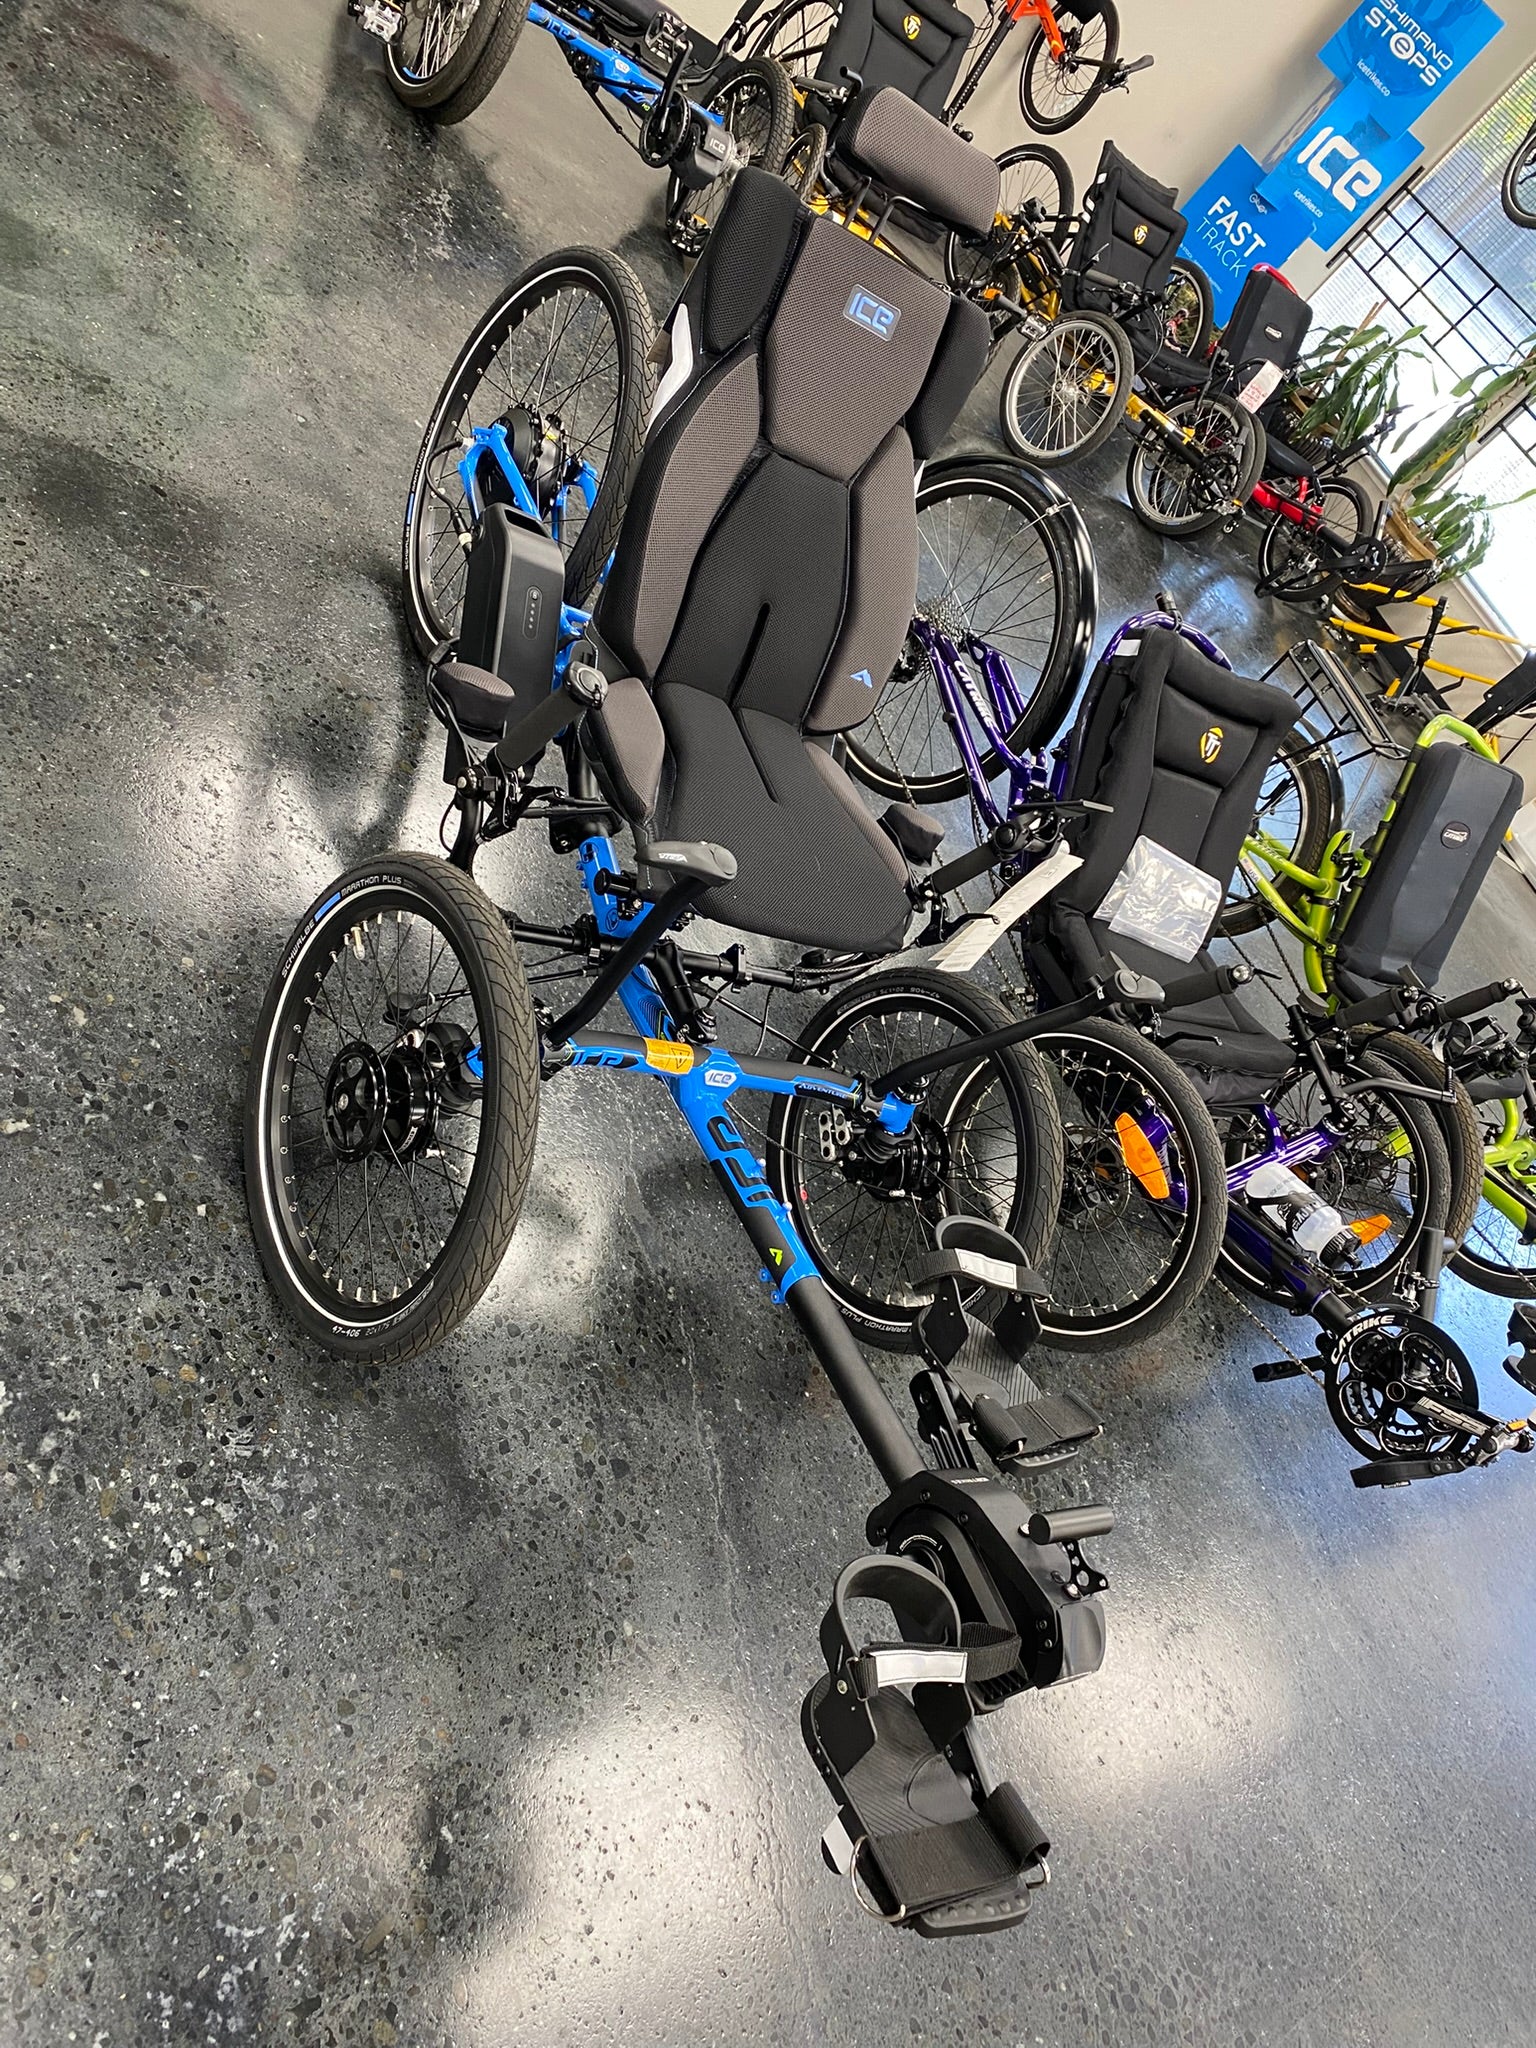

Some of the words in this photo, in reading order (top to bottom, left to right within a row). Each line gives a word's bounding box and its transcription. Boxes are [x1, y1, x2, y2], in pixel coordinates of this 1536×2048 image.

[1379, 0, 1453, 70] SHIMANO
[1356, 58, 1391, 97] icetrikes.co
[1196, 216, 1247, 278] TRACK
[1207, 195, 1267, 258] FAST
[281, 918, 315, 979] SCHWALBE
[340, 875, 380, 897] MARATHON
[382, 874, 402, 885] PLUS
[840, 1307, 862, 1321] PLUS
[863, 1319, 909, 1333] MARATHON
[1330, 1314, 1395, 1365] CATRIKE
